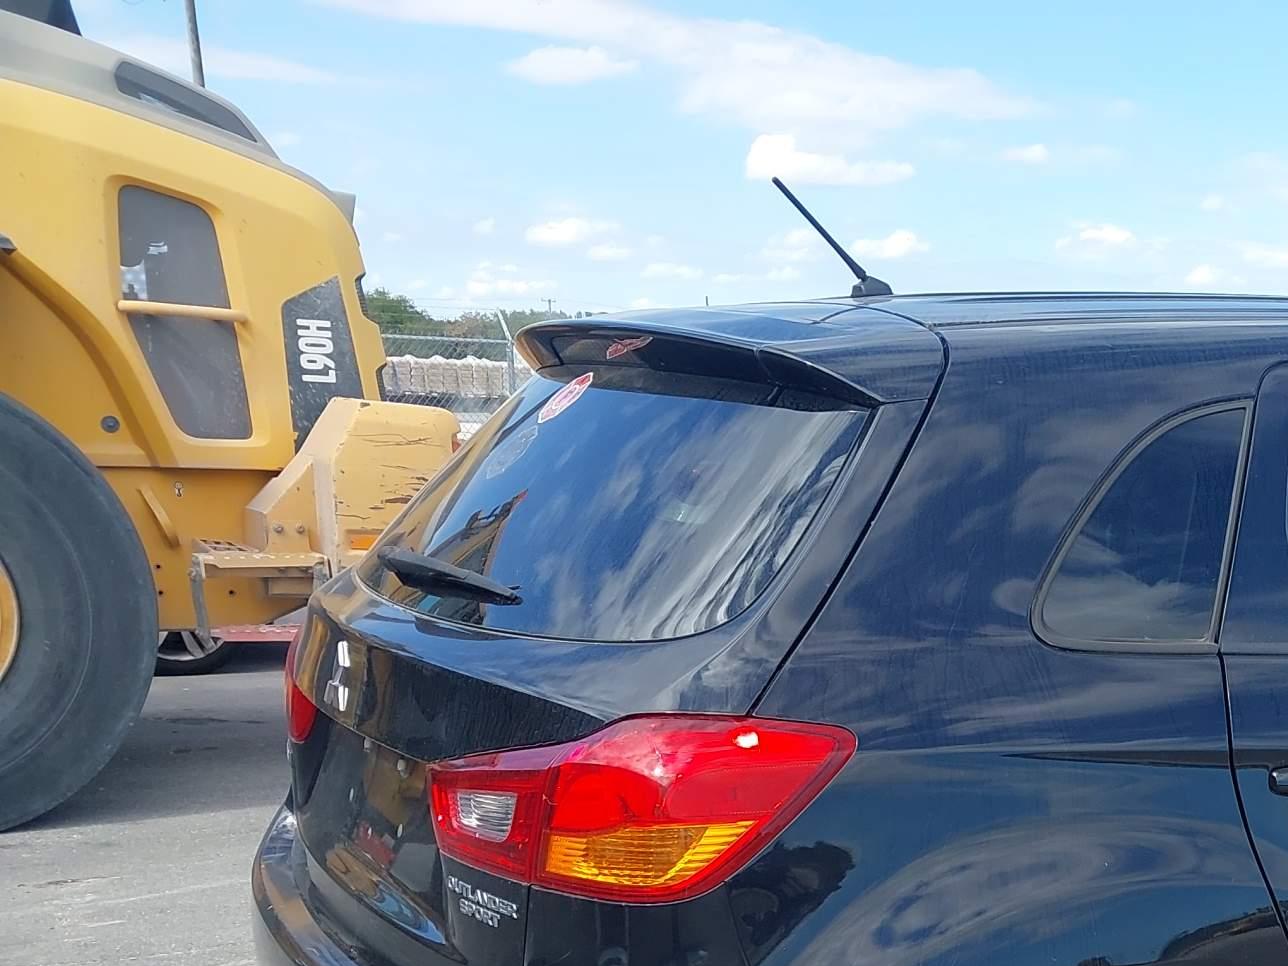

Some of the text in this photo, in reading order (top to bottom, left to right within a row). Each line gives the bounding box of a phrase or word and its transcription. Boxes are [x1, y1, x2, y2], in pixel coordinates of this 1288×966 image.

[296, 318, 337, 384] L90H
[448, 875, 518, 919] OUTLANDER
[459, 898, 501, 928] SPORT
